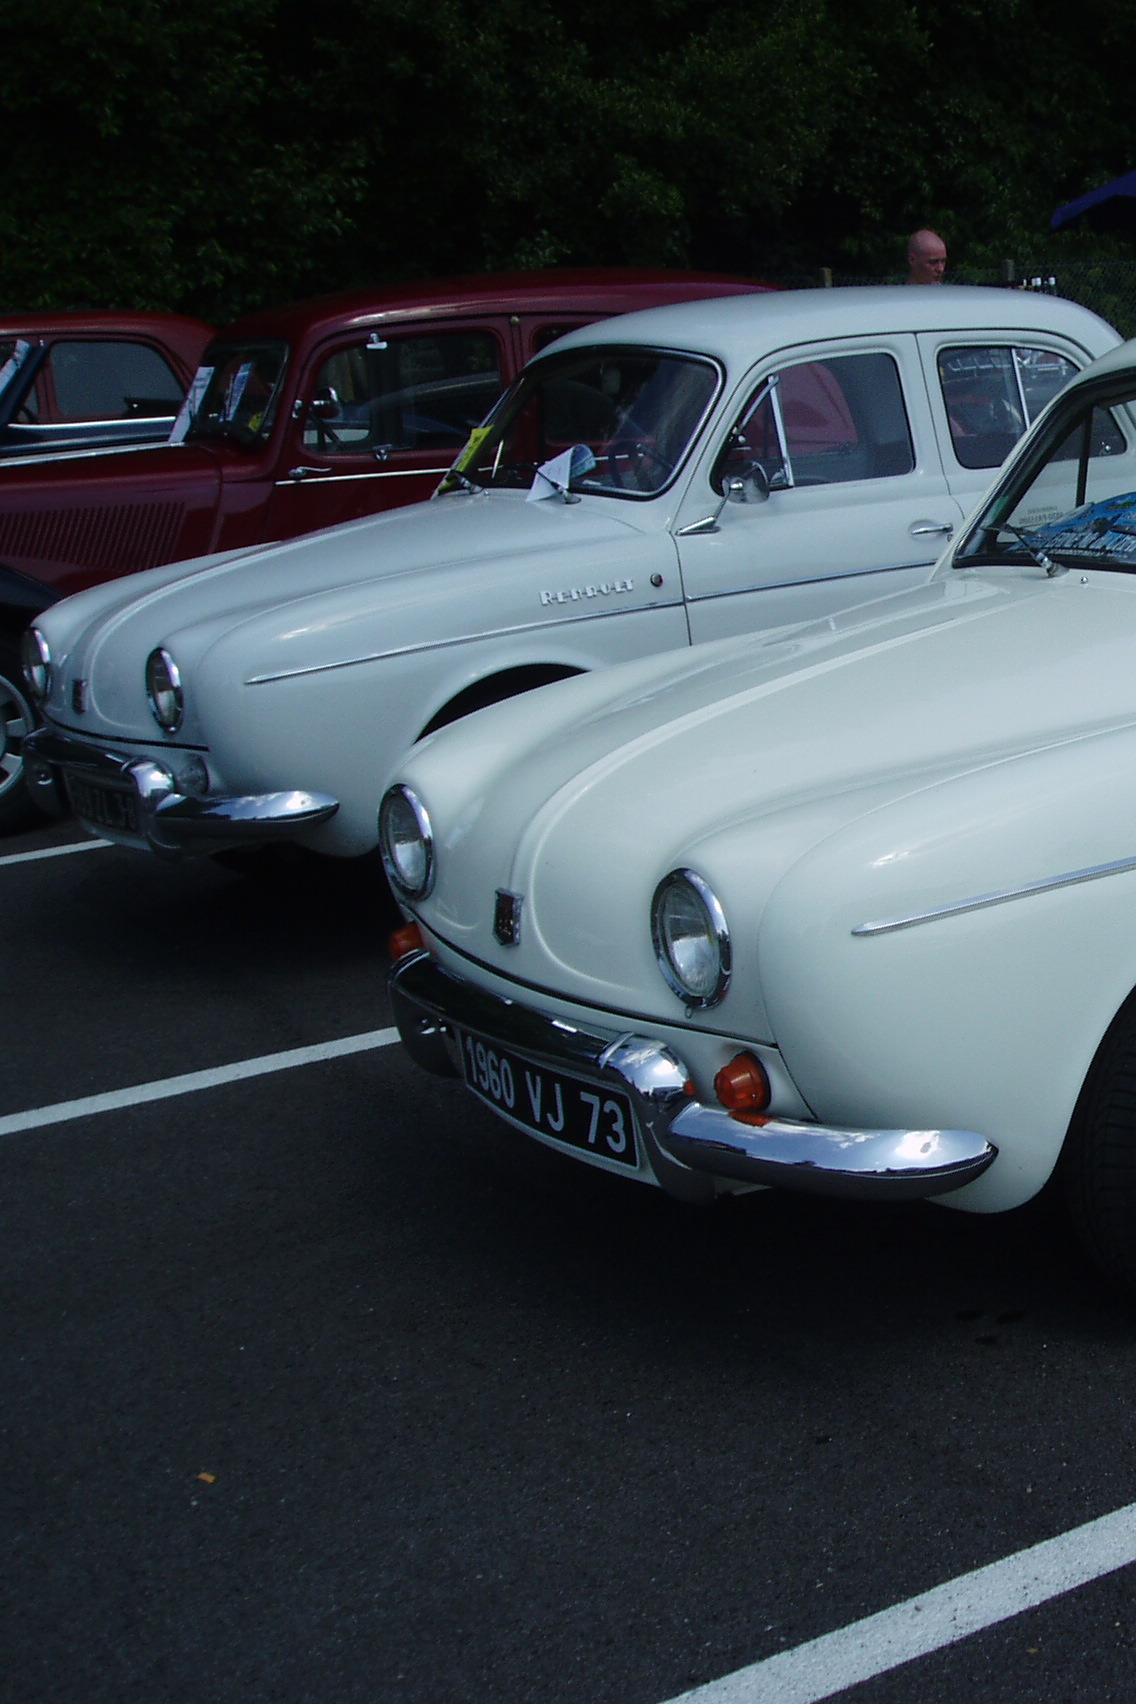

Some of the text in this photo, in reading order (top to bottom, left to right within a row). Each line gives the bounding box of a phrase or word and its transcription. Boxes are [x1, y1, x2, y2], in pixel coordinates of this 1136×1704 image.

[465, 1035, 627, 1154] 1960 VJ 73
